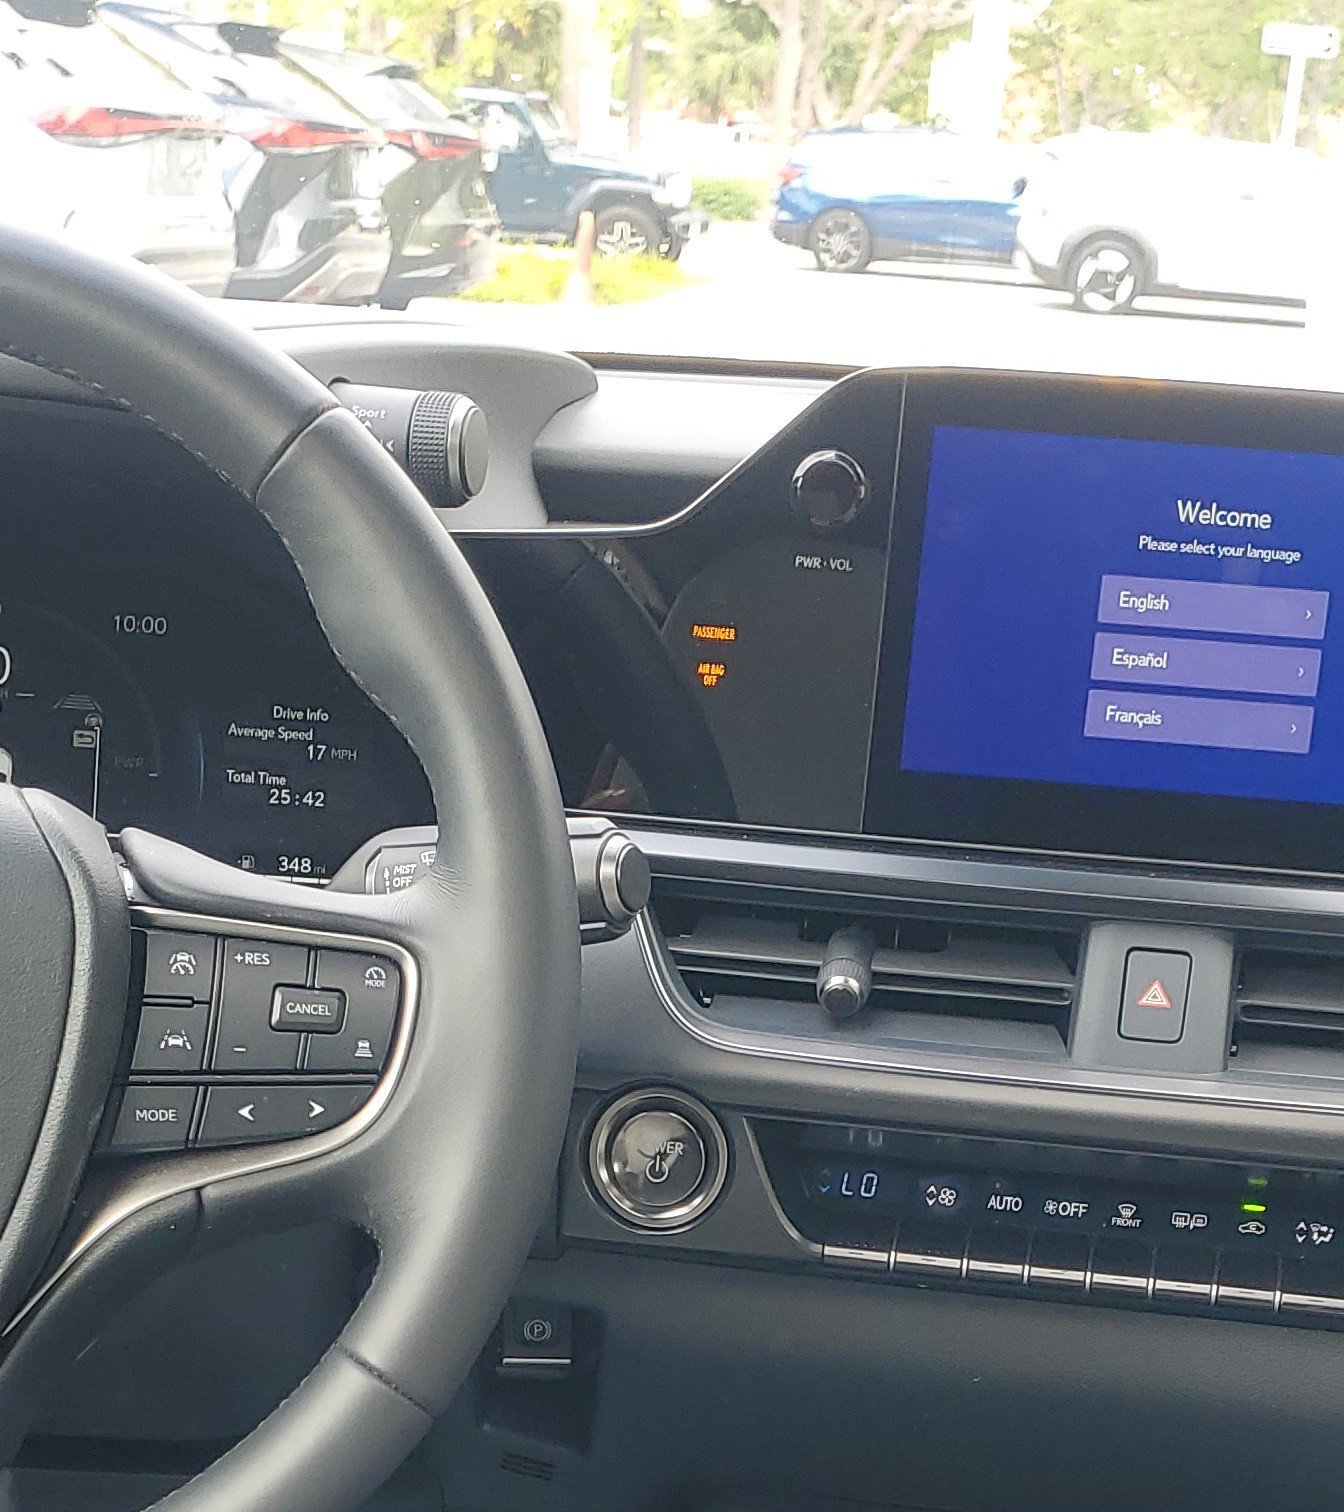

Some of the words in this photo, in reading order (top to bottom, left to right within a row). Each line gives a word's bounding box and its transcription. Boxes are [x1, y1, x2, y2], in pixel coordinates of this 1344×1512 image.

[352, 405, 386, 421] Sport
[1176, 499, 1273, 530] Welcome
[1138, 535, 1178, 553] Please
[1179, 539, 1215, 556] select
[1217, 544, 1245, 560] your
[1246, 543, 1302, 565] language
[795, 554, 821, 570] PWR
[829, 557, 853, 572] VOL
[1118, 590, 1170, 613] English
[112, 613, 168, 636] 10:00
[692, 624, 735, 640] PASSENGER
[1112, 647, 1168, 669] Español
[703, 674, 717, 686] OFF
[273, 705, 304, 721] Drive
[306, 707, 329, 722] Info
[1105, 706, 1163, 728] Français
[227, 721, 275, 741] Average
[277, 726, 313, 742] Speed
[307, 744, 327, 761] 17
[331, 747, 357, 760] MPH
[226, 769, 255, 784] Total
[257, 770, 287, 787] Time
[269, 788, 325, 807] 25:42
[278, 856, 312, 873] 348
[393, 863, 417, 876] MIST
[392, 875, 413, 889] OFF
[234, 952, 271, 967] +RES
[364, 978, 386, 989] MODE
[286, 1002, 332, 1017] CANCEL
[135, 1108, 178, 1123] MODE
[840, 1172, 879, 1199] LO
[987, 1193, 1023, 1212] AUTO
[1058, 1201, 1089, 1219] OFF
[1111, 1216, 1143, 1229] FRONT
